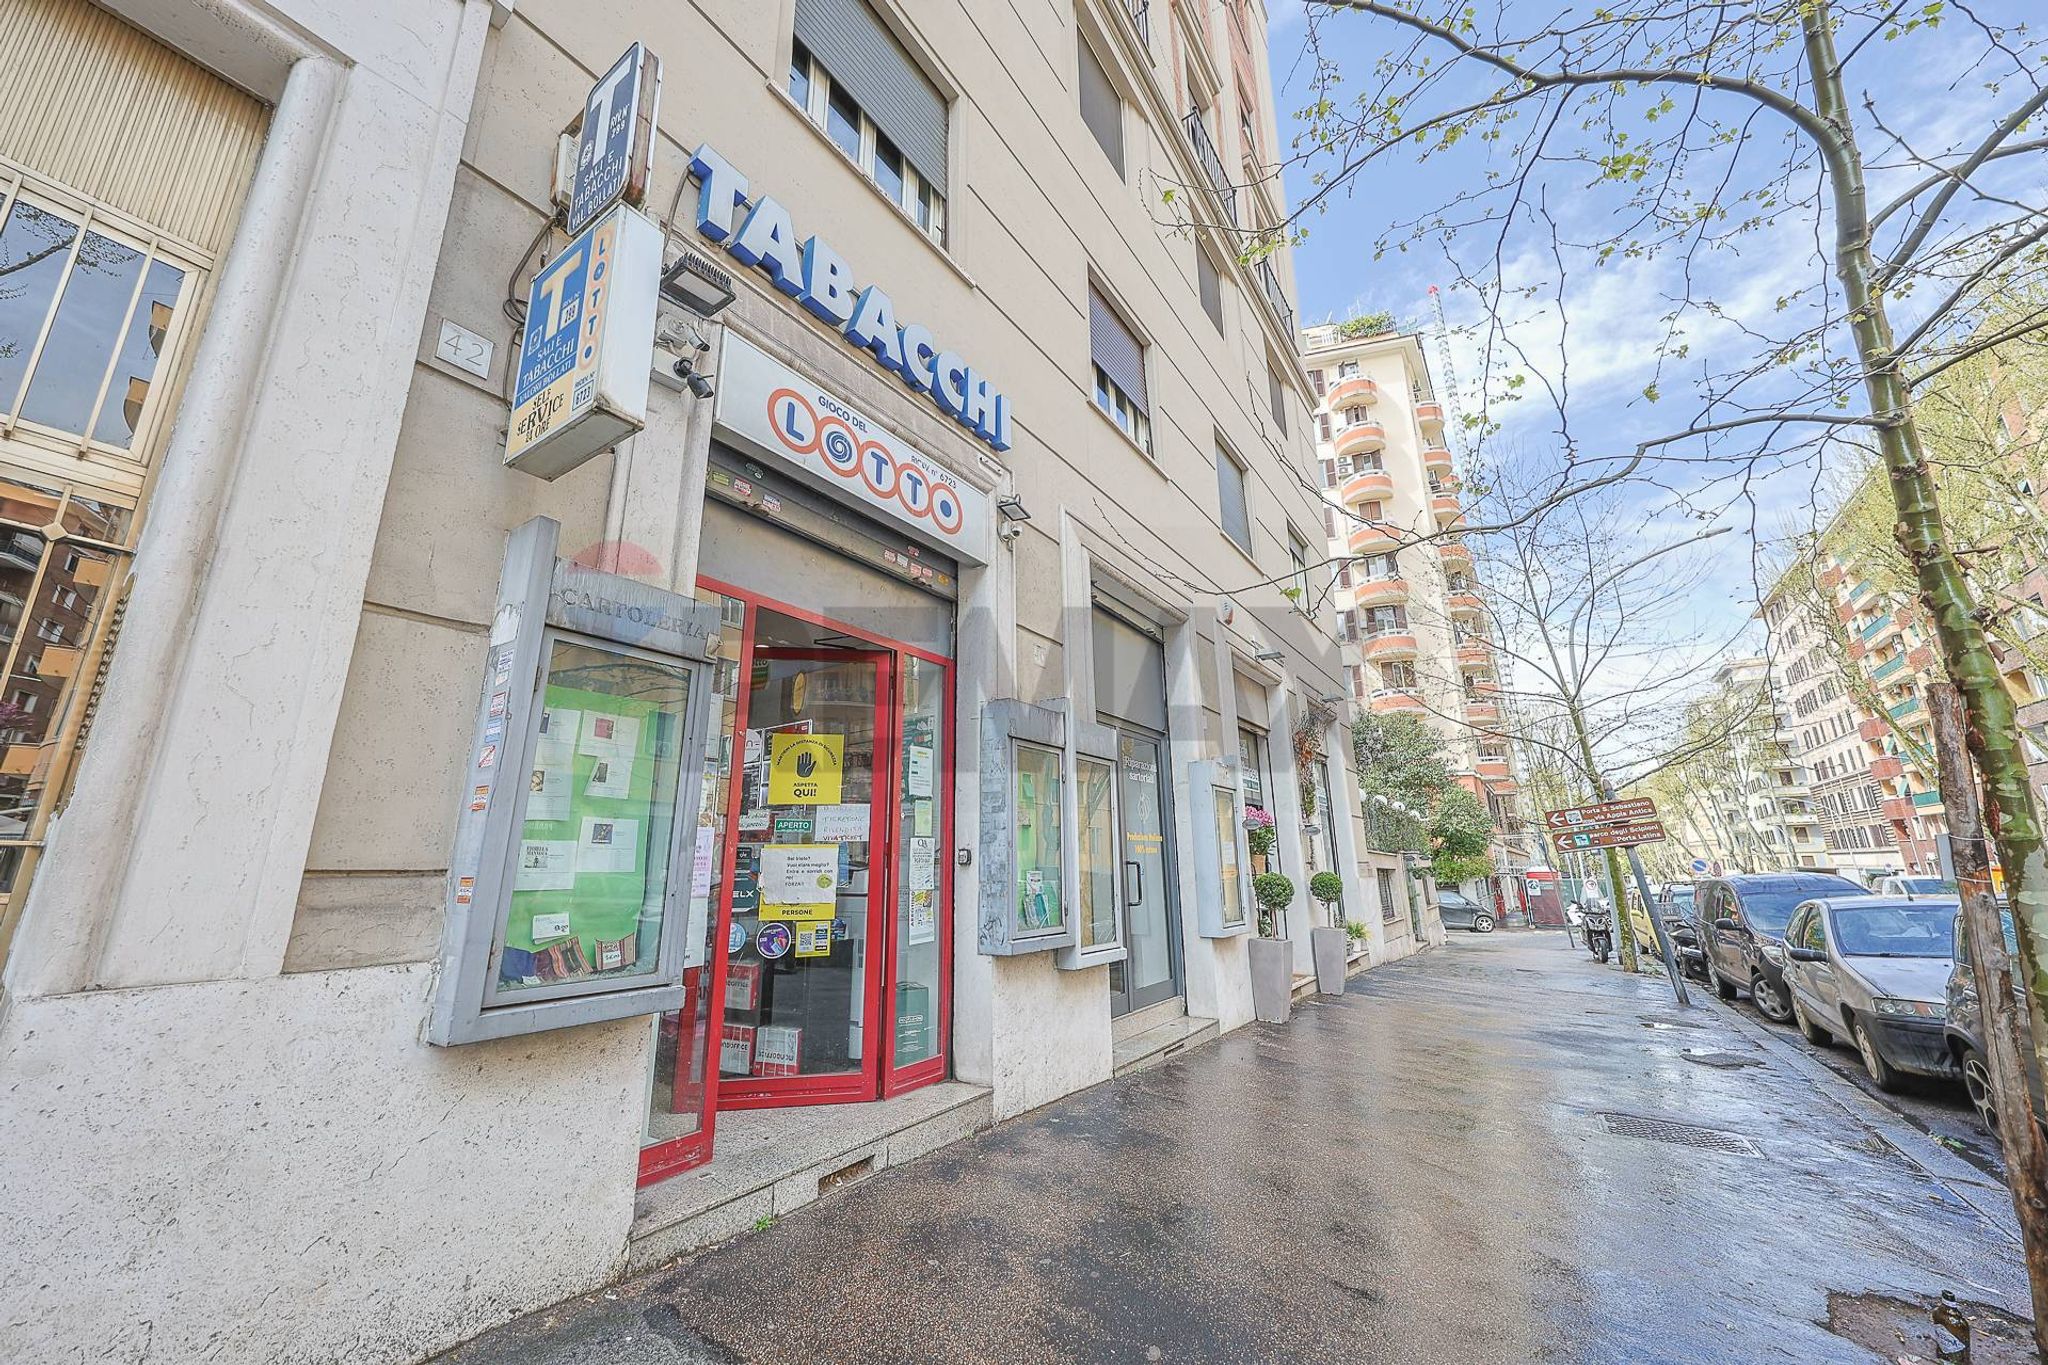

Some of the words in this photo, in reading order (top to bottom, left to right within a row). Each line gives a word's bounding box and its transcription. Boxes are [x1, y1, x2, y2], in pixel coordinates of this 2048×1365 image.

[590, 54, 633, 167] T
[574, 156, 623, 212] TABACCHI
[584, 160, 604, 187] SALI
[607, 149, 614, 163] E
[587, 174, 622, 215] BOLLATI
[540, 249, 584, 342] T
[689, 143, 1011, 452] TABACCHI
[443, 334, 483, 367] 42
[522, 338, 576, 388] TABACCHI
[536, 338, 555, 363] SALI
[555, 334, 562, 347] E
[518, 382, 543, 404] VALORI
[543, 361, 573, 388] BOLLATI
[532, 388, 552, 411] SELF
[575, 386, 591, 405] 6723
[517, 393, 565, 435] SERVICE
[818, 395, 850, 422] GIOCO
[851, 416, 868, 434] DEL
[525, 429, 534, 444] 24
[533, 420, 552, 441] ORE
[780, 398, 955, 524] LOTTO
[939, 473, 957, 489] 6723
[562, 588, 706, 640] CARTOLERIA
[793, 788, 817, 798] QUI!
[1581, 807, 1601, 815] Porta
[1610, 800, 1650, 812] Sebastiano
[777, 821, 810, 830] APERTO
[1589, 830, 1608, 838] parco
[1610, 828, 1628, 836] degli
[1629, 824, 1659, 833] Scipioni
[1594, 813, 1605, 821] via
[1606, 811, 1628, 820] Appia
[1629, 807, 1653, 816] Antica
[1638, 832, 1661, 840] Latina
